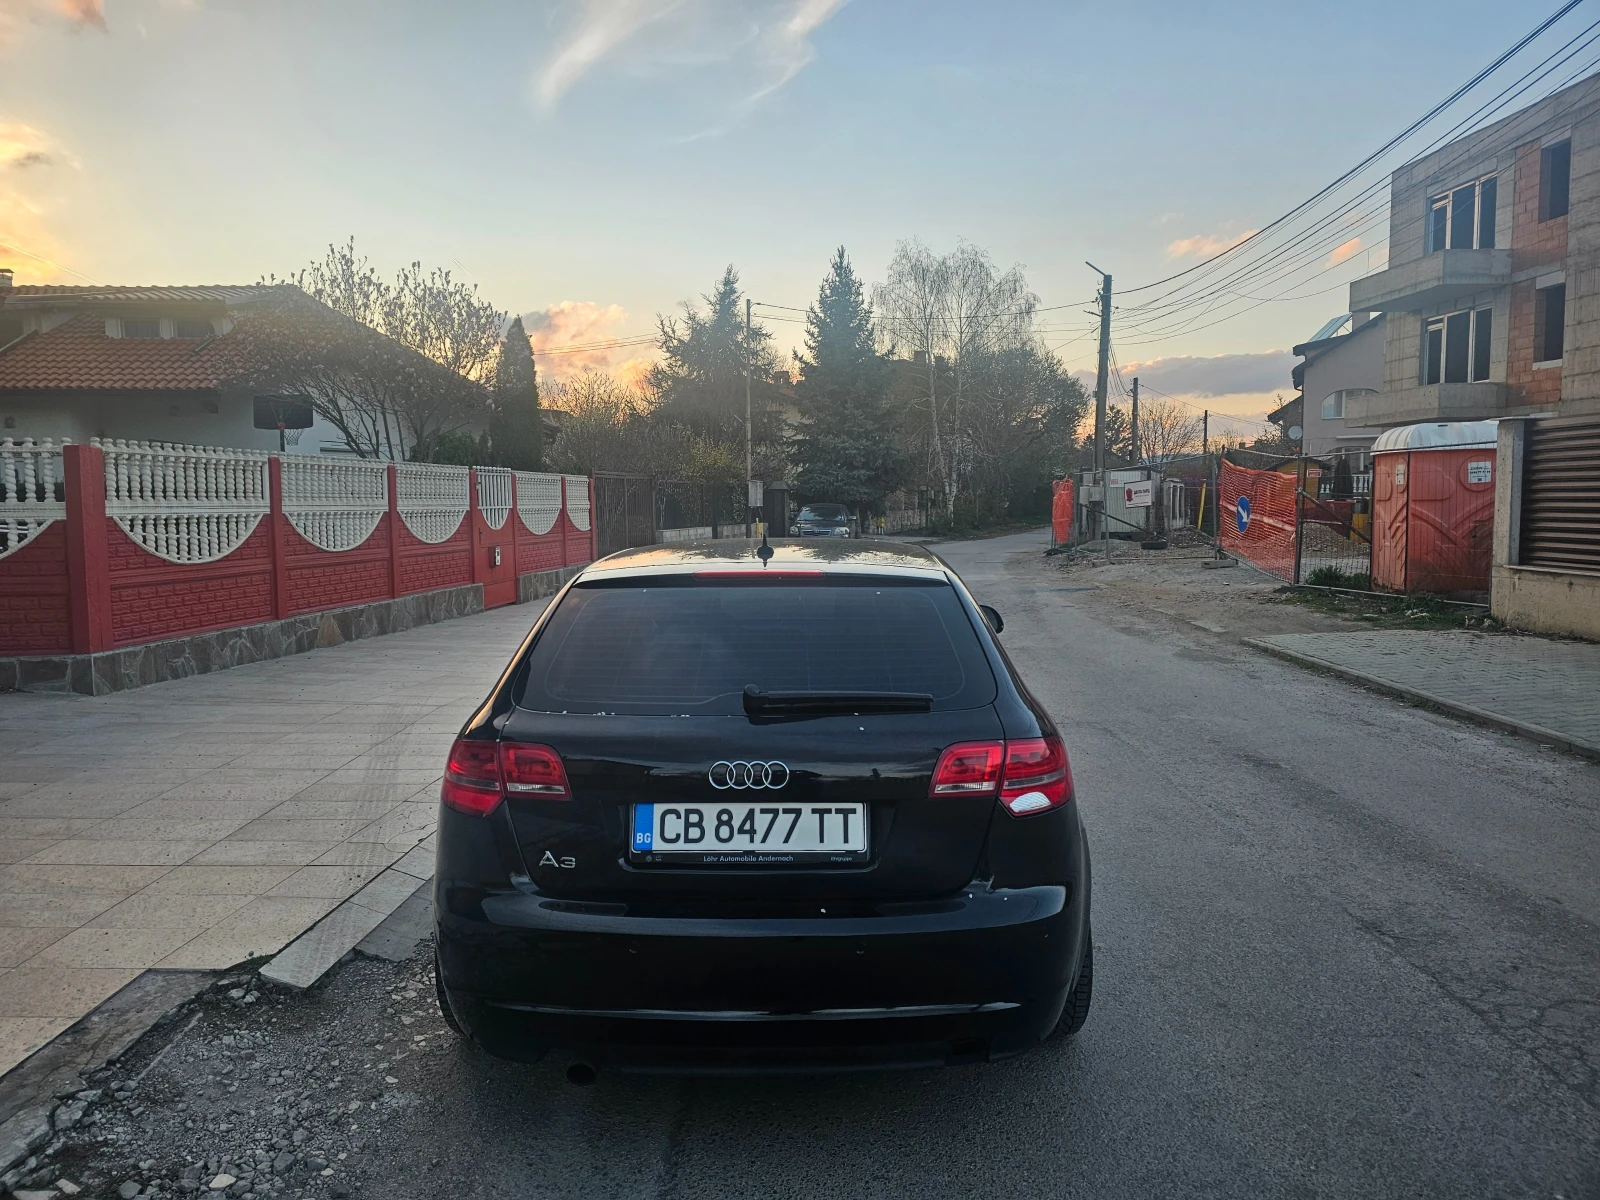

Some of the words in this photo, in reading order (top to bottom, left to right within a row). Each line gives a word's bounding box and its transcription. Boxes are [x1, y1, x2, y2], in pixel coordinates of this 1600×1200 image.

[659, 808, 706, 844] CB
[714, 808, 803, 844] 8477
[811, 808, 857, 844] TT
[636, 832, 652, 844] BG
[538, 850, 576, 869] A3
[719, 855, 757, 863] Automobile
